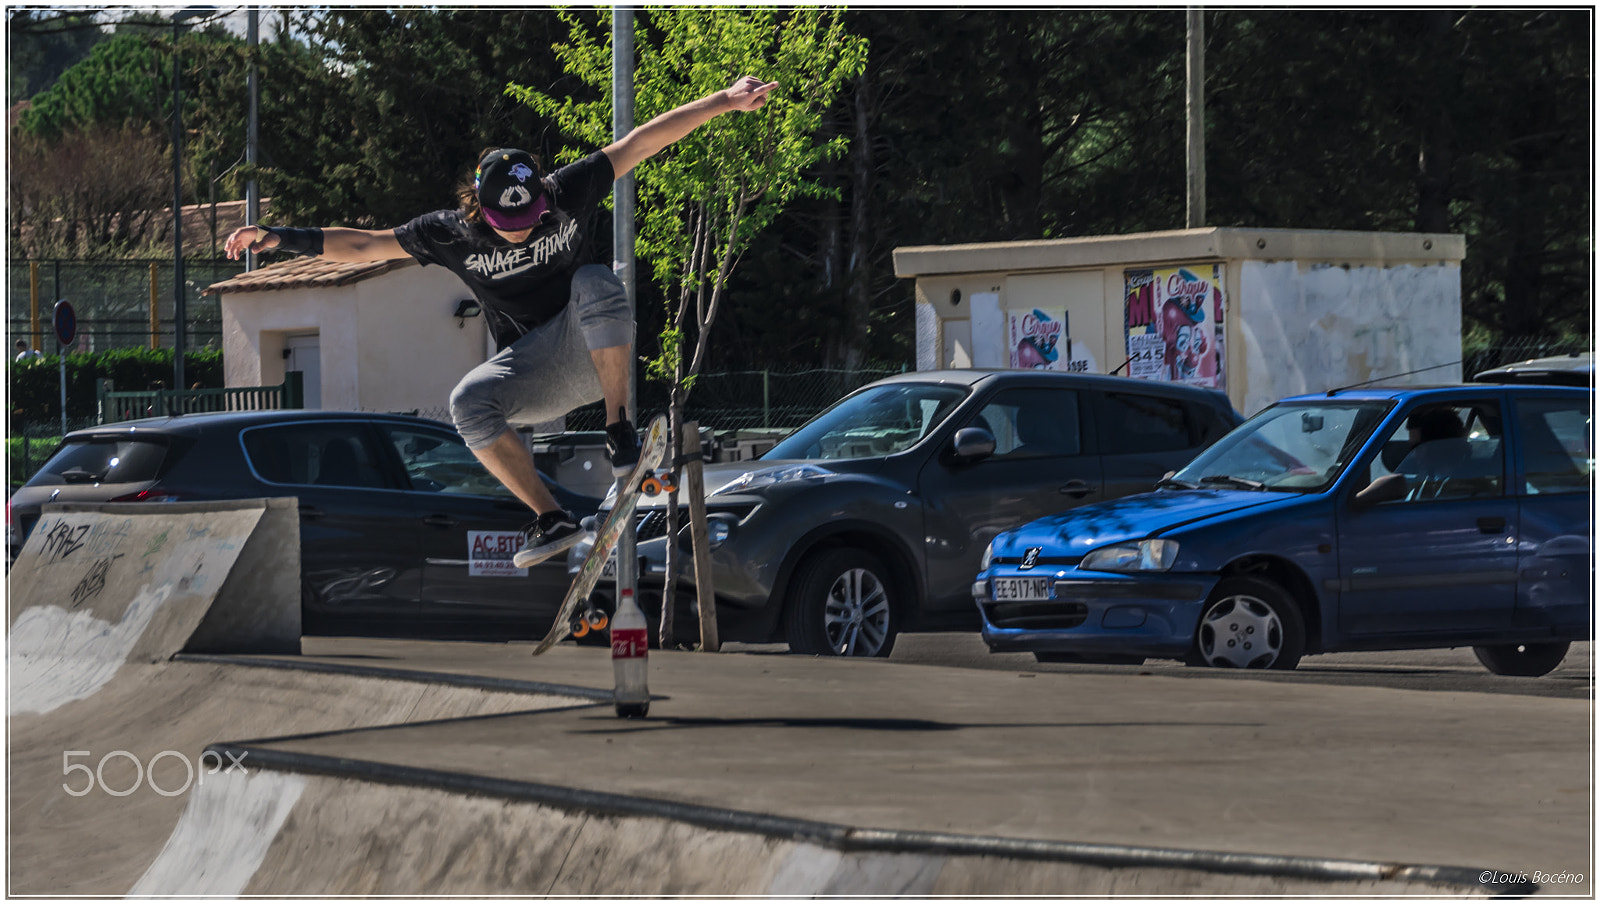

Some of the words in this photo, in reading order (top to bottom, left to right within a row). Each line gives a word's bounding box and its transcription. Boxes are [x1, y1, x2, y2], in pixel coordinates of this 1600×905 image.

[464, 247, 531, 276] SAVAGE
[529, 218, 578, 265] THINGS
[1167, 273, 1209, 303] Cirque
[1022, 314, 1061, 339] Cirque
